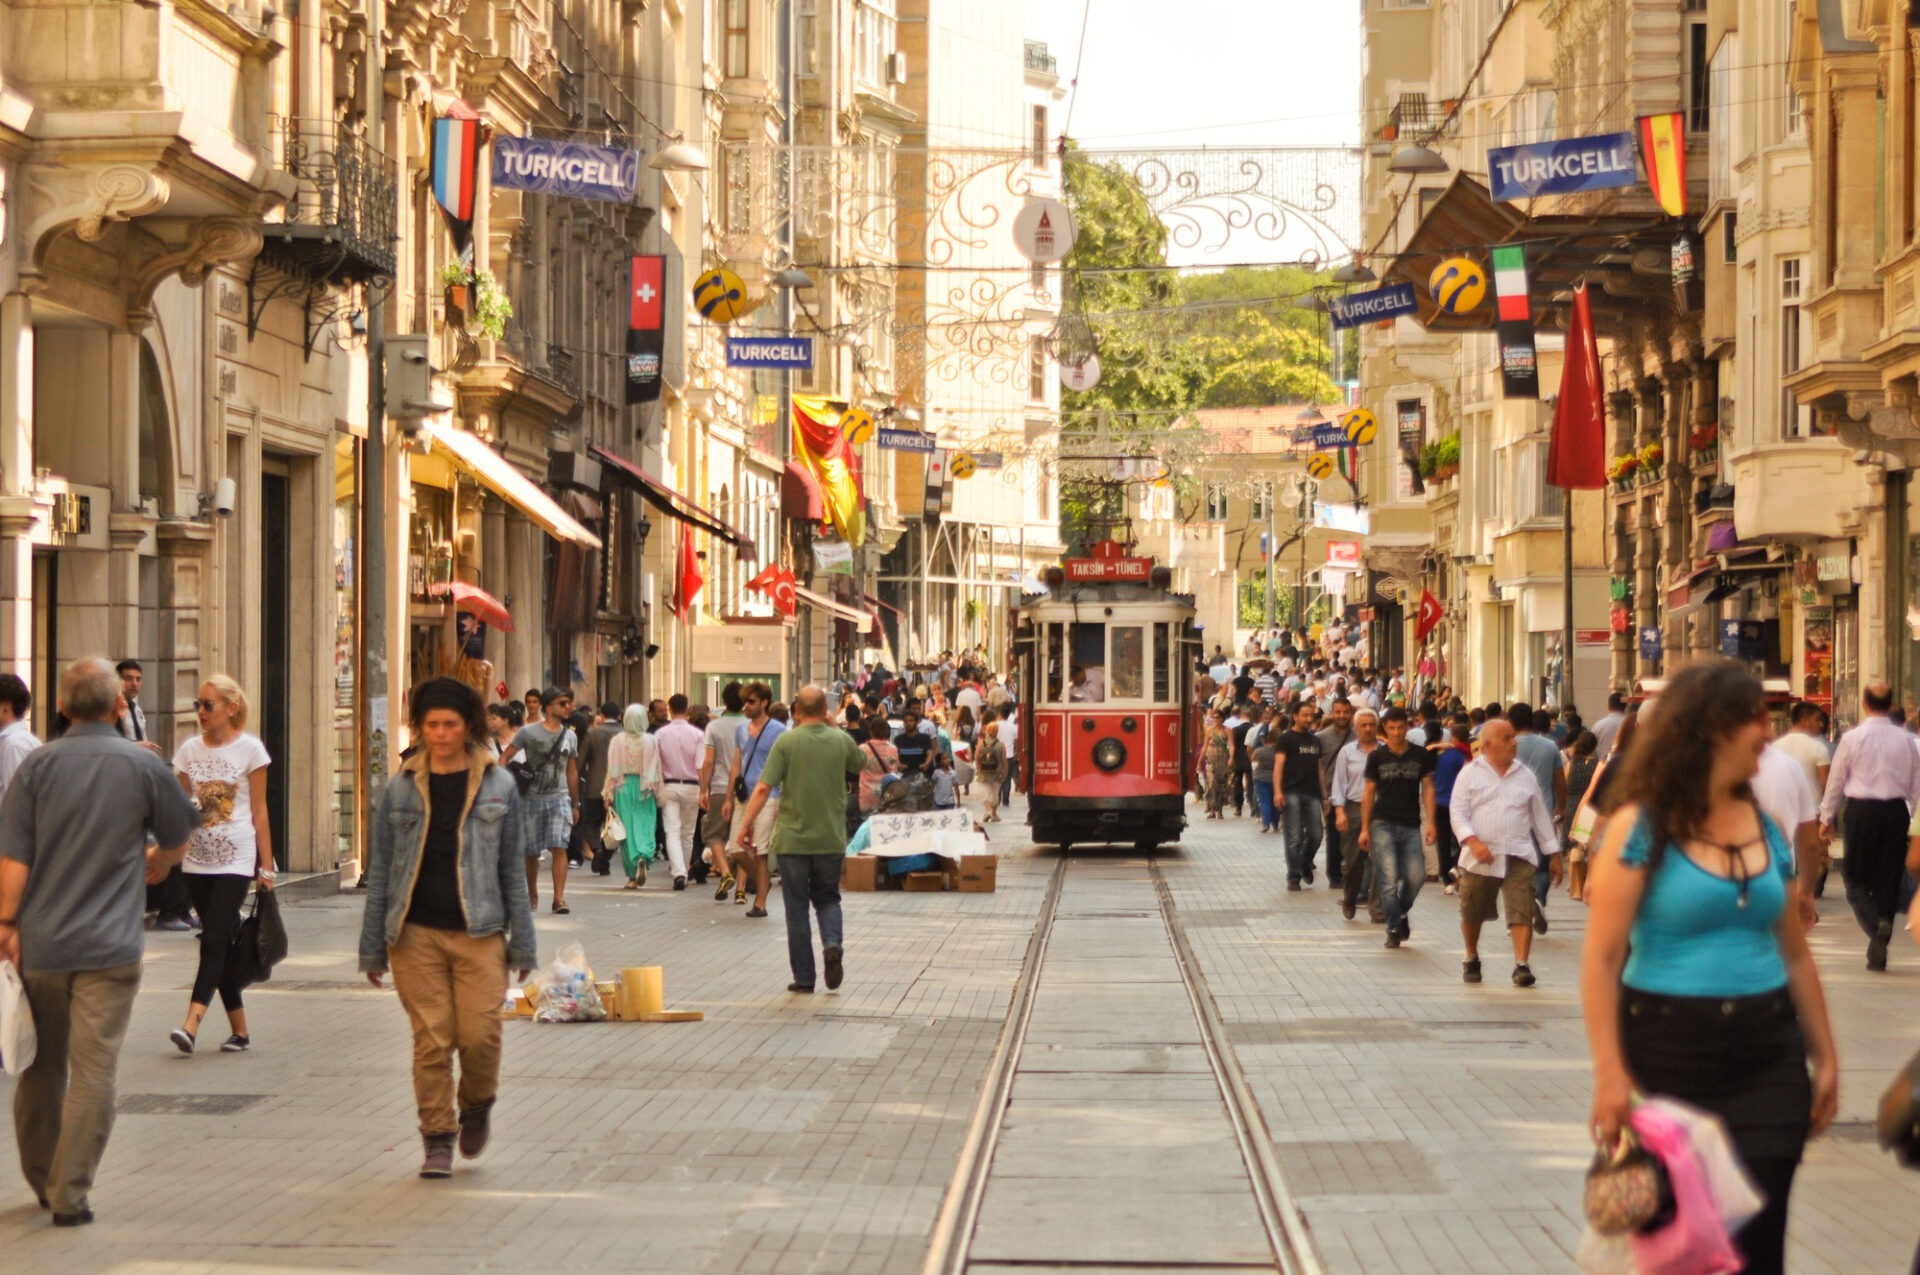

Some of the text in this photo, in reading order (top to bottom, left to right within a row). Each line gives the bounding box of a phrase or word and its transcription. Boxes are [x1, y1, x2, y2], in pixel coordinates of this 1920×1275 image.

[501, 150, 626, 188] TURKCELL
[1495, 149, 1627, 185] TURKCELL
[1335, 293, 1412, 321] TURKCELL
[730, 344, 808, 361] TURKCELL
[880, 434, 933, 450] TURKCELL
[1104, 542, 1110, 556] 1
[1115, 560, 1145, 577] TÜNEL
[1038, 722, 1049, 737] 47
[1168, 722, 1178, 737] 47
